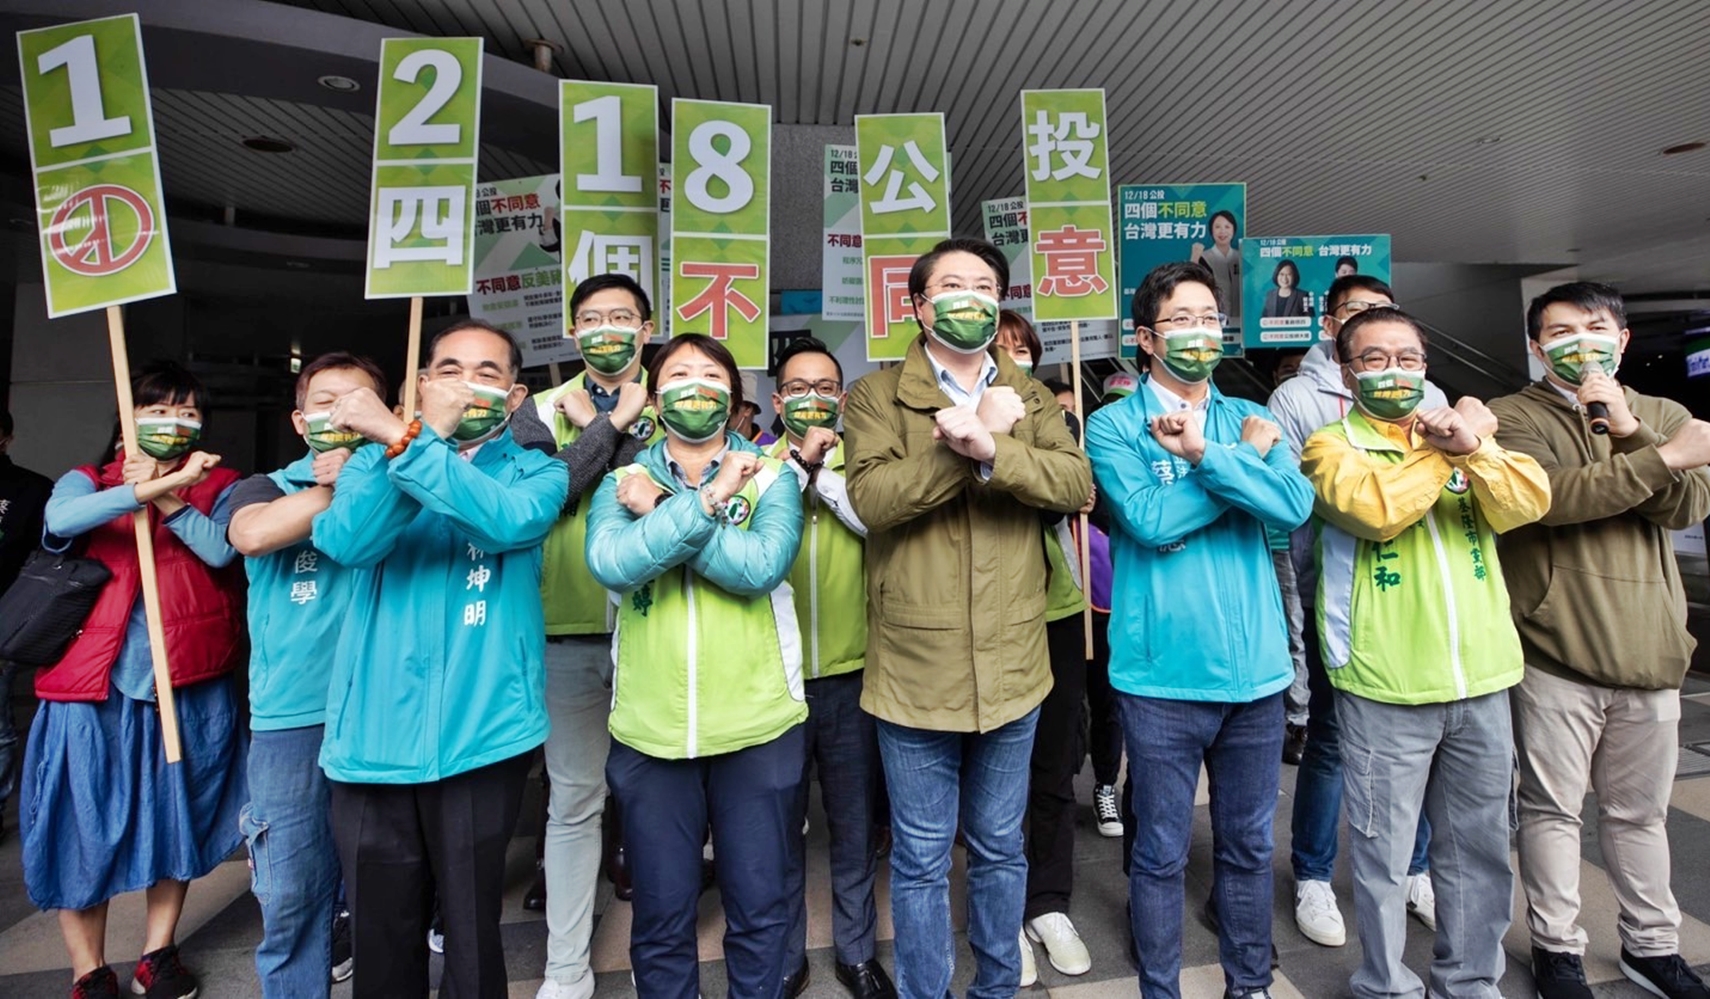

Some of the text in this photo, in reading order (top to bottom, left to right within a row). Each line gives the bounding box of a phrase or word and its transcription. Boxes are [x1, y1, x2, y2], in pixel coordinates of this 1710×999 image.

[37, 34, 132, 148] 1
[388, 49, 462, 146] 2
[573, 95, 642, 192] 1
[684, 120, 754, 213] 8
[863, 140, 940, 214] 公
[1028, 110, 1102, 182] 投
[373, 185, 466, 269] 四
[475, 213, 544, 237] 灣更有力
[1123, 221, 1206, 240] 台灣更有力
[1124, 201, 1207, 219] 四個不同意
[1035, 225, 1109, 297] 意
[676, 261, 761, 340] 不
